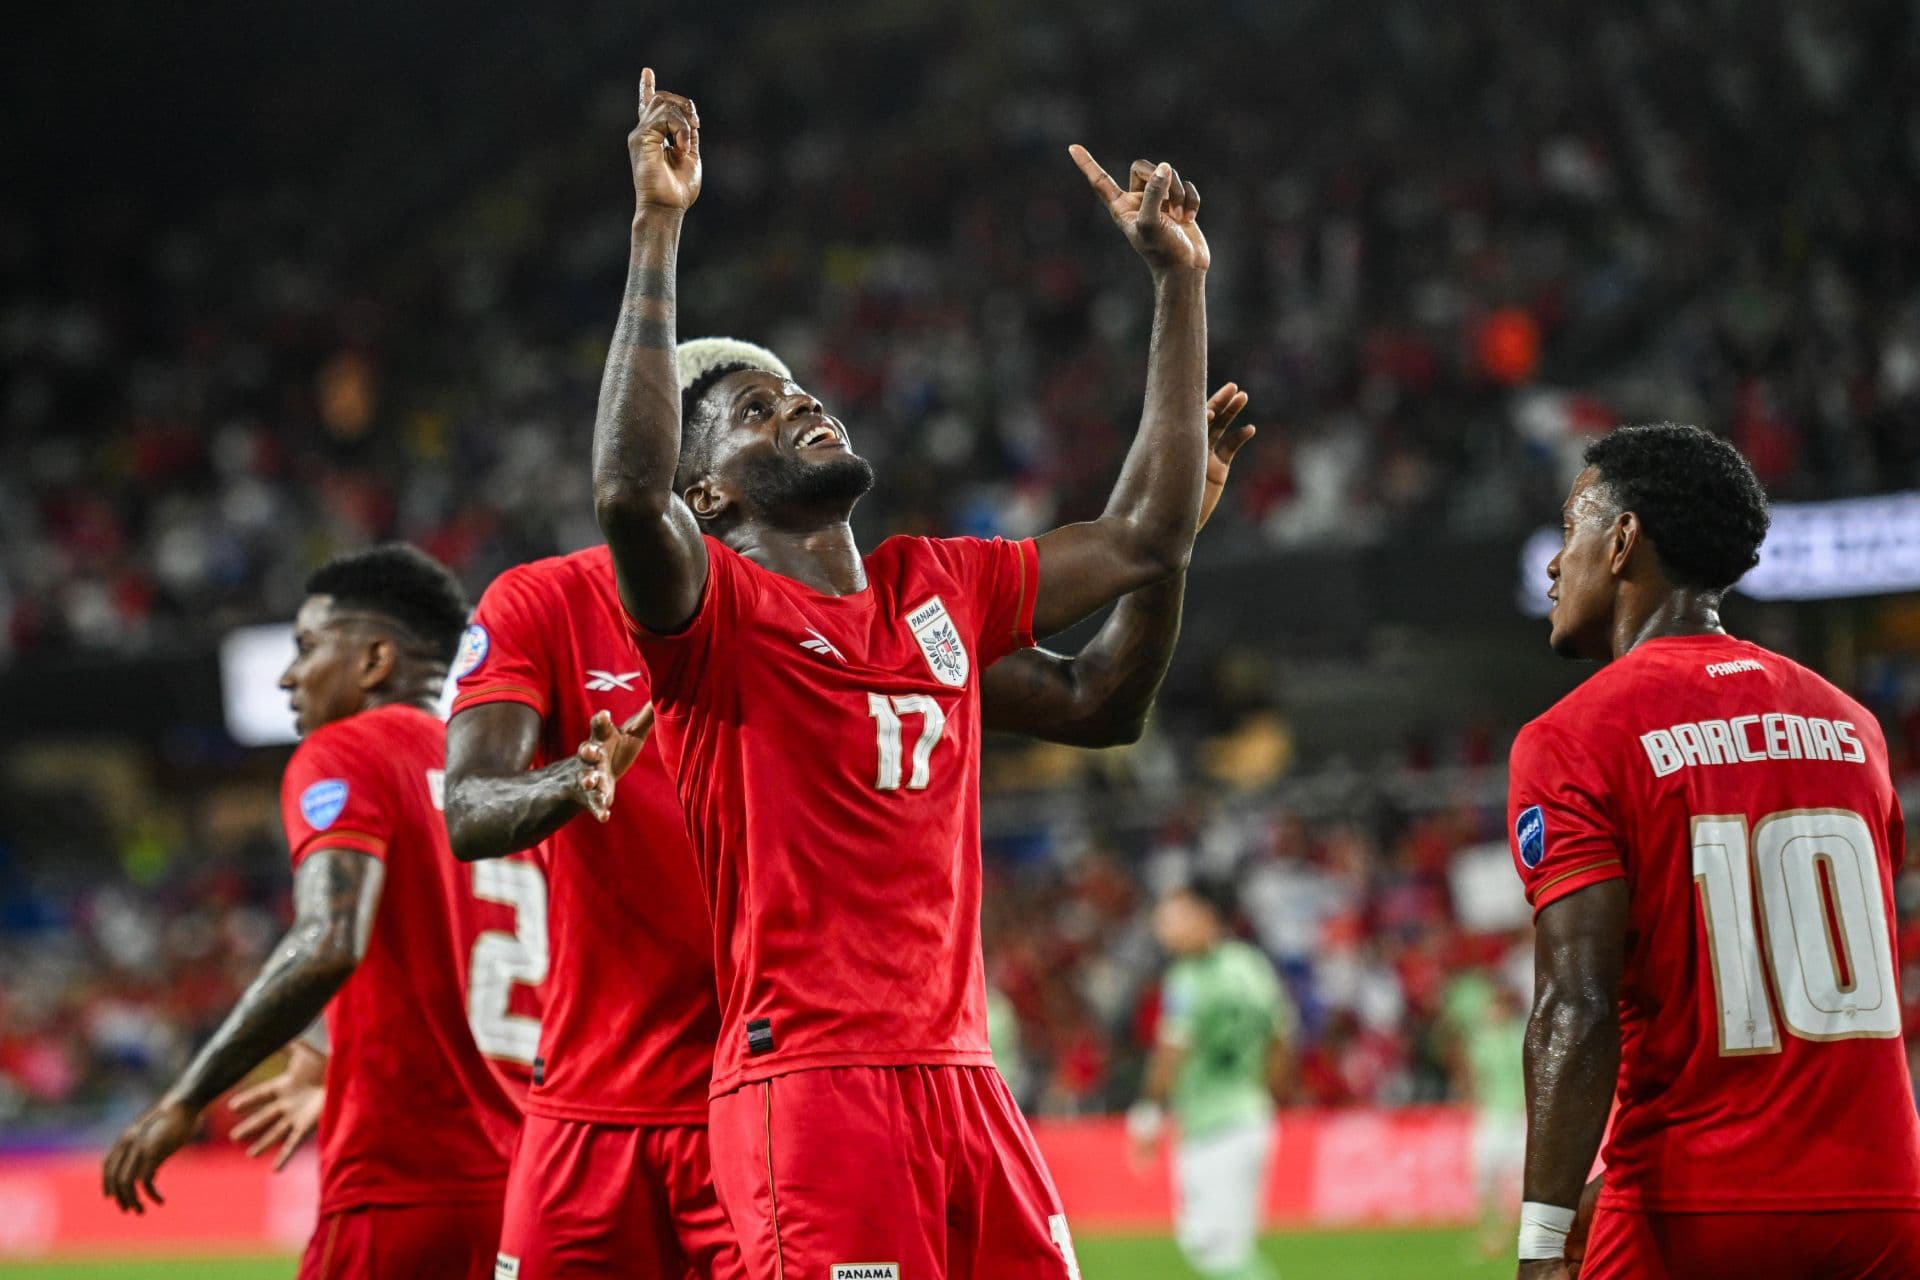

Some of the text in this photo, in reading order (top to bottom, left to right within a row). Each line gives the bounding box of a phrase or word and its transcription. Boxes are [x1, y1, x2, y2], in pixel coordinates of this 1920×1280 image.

[867, 692, 946, 791] 17
[1640, 712, 1866, 778] BARCENAS
[467, 857, 550, 1066] 2
[1690, 808, 1901, 1057] 10
[837, 1266, 893, 1280] PANAMÁ
